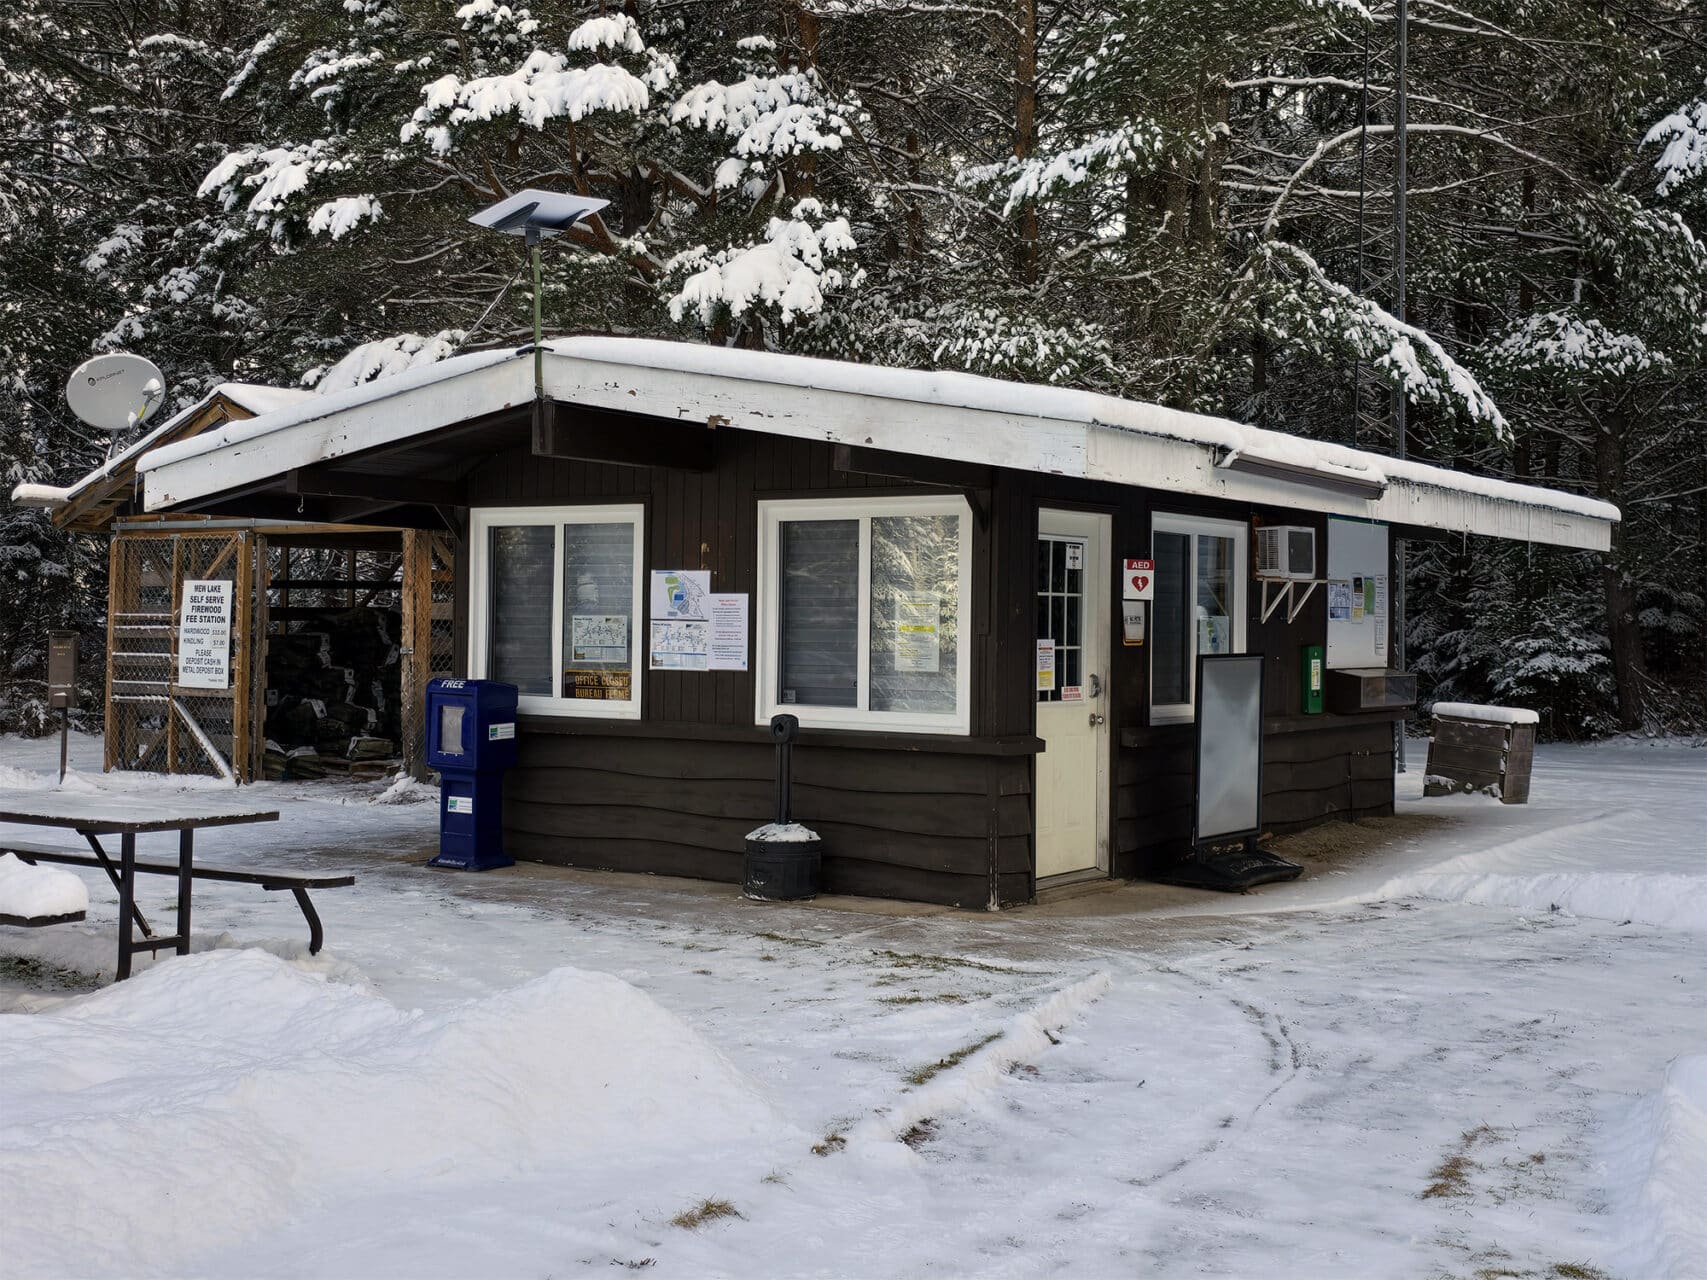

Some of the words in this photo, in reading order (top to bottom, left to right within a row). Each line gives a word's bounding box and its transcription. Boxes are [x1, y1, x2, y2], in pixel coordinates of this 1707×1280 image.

[1131, 561, 1150, 569] AED
[194, 585, 206, 593] MEW
[207, 585, 221, 593] LAKE
[190, 595, 204, 604] SELF
[205, 596, 224, 604] SERVE
[191, 605, 222, 613] FIREWOOD
[186, 615, 197, 623] FEE
[199, 615, 226, 624] STATION
[195, 649, 212, 657] PLEASE
[186, 657, 203, 665] DEPOSIT
[204, 658, 216, 666] CASH
[183, 666, 196, 674] METAL
[214, 667, 225, 675] BOX
[441, 679, 467, 688] FREE
[575, 675, 599, 685] OFFICE
[601, 675, 629, 687] CLOSED
[575, 688, 603, 698] BUREAU
